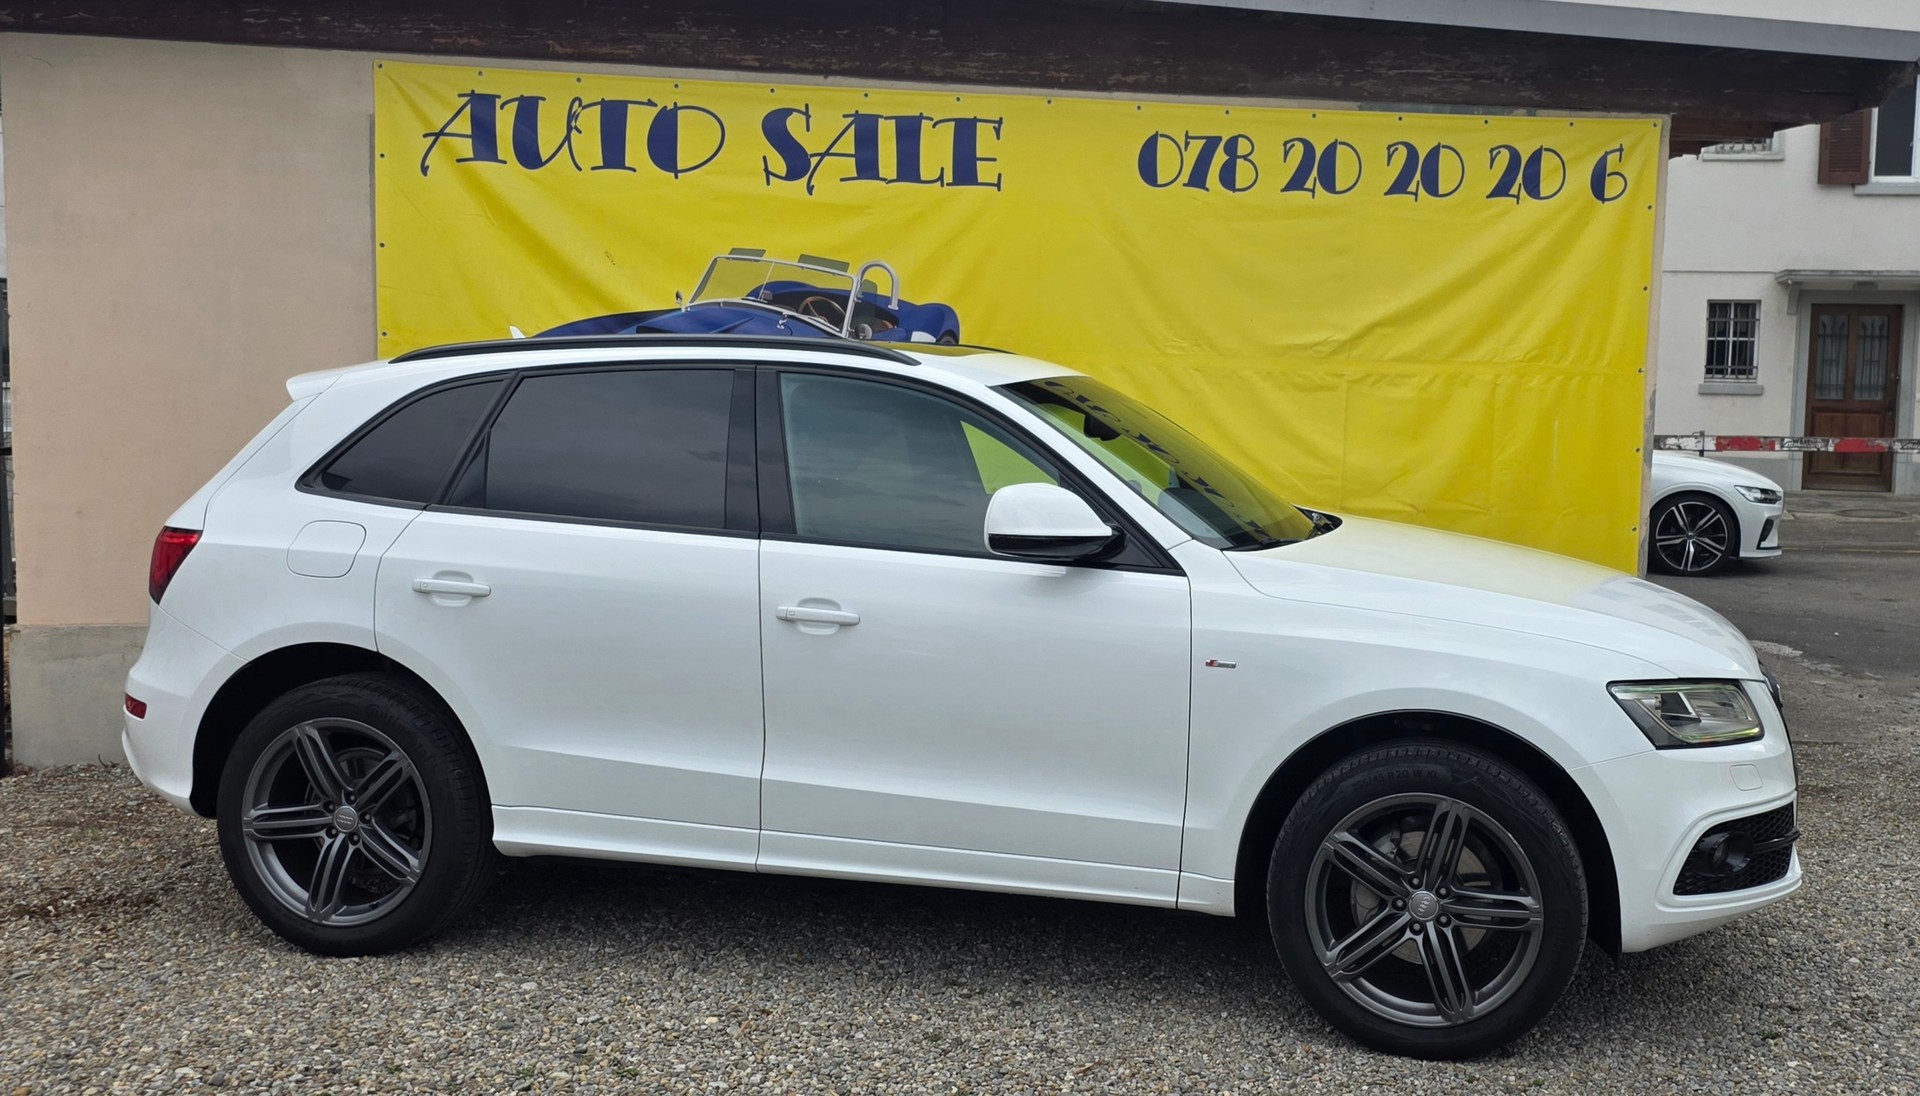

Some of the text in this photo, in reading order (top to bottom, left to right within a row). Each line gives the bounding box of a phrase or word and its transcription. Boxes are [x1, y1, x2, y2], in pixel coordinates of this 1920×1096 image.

[419, 88, 1004, 196] AUTO SALE
[1137, 130, 1628, 205] 078 20 20 20 6
[1412, 769, 1423, 778] W
[1426, 769, 1440, 780] XL
